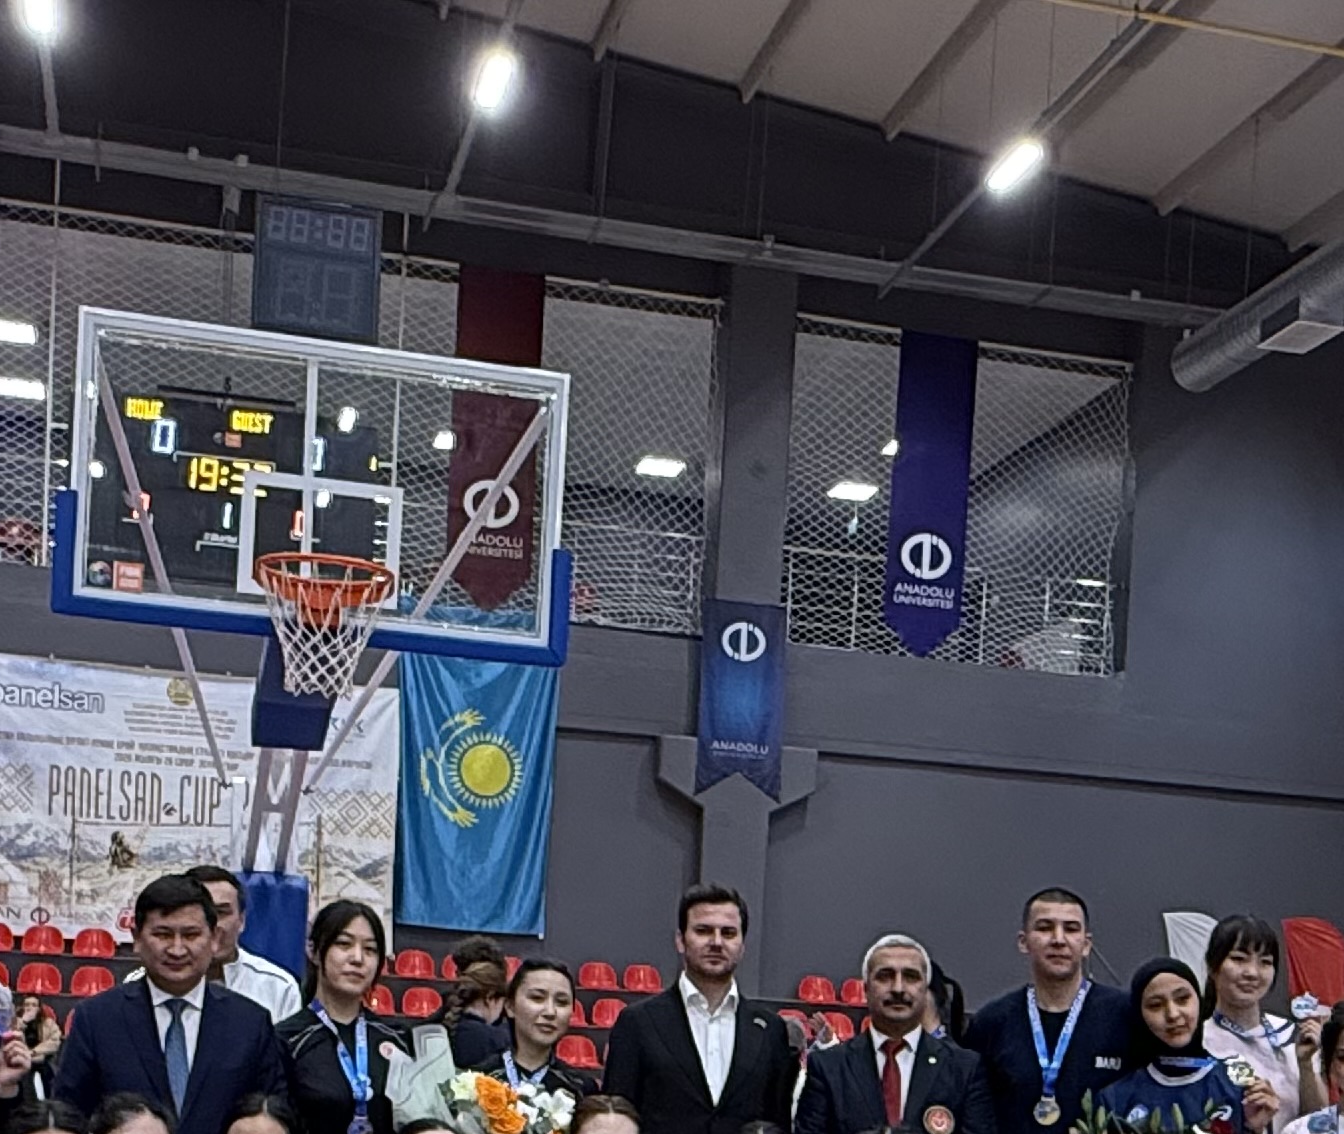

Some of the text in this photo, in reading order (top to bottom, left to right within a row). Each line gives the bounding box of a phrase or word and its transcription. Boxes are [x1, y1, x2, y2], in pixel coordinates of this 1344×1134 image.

[232, 410, 274, 434] GUEST
[894, 582, 955, 599] ANADOLU
[710, 740, 769, 755] ANADOLU
[48, 764, 163, 825] PANELSAN
[179, 774, 222, 827] CUP
